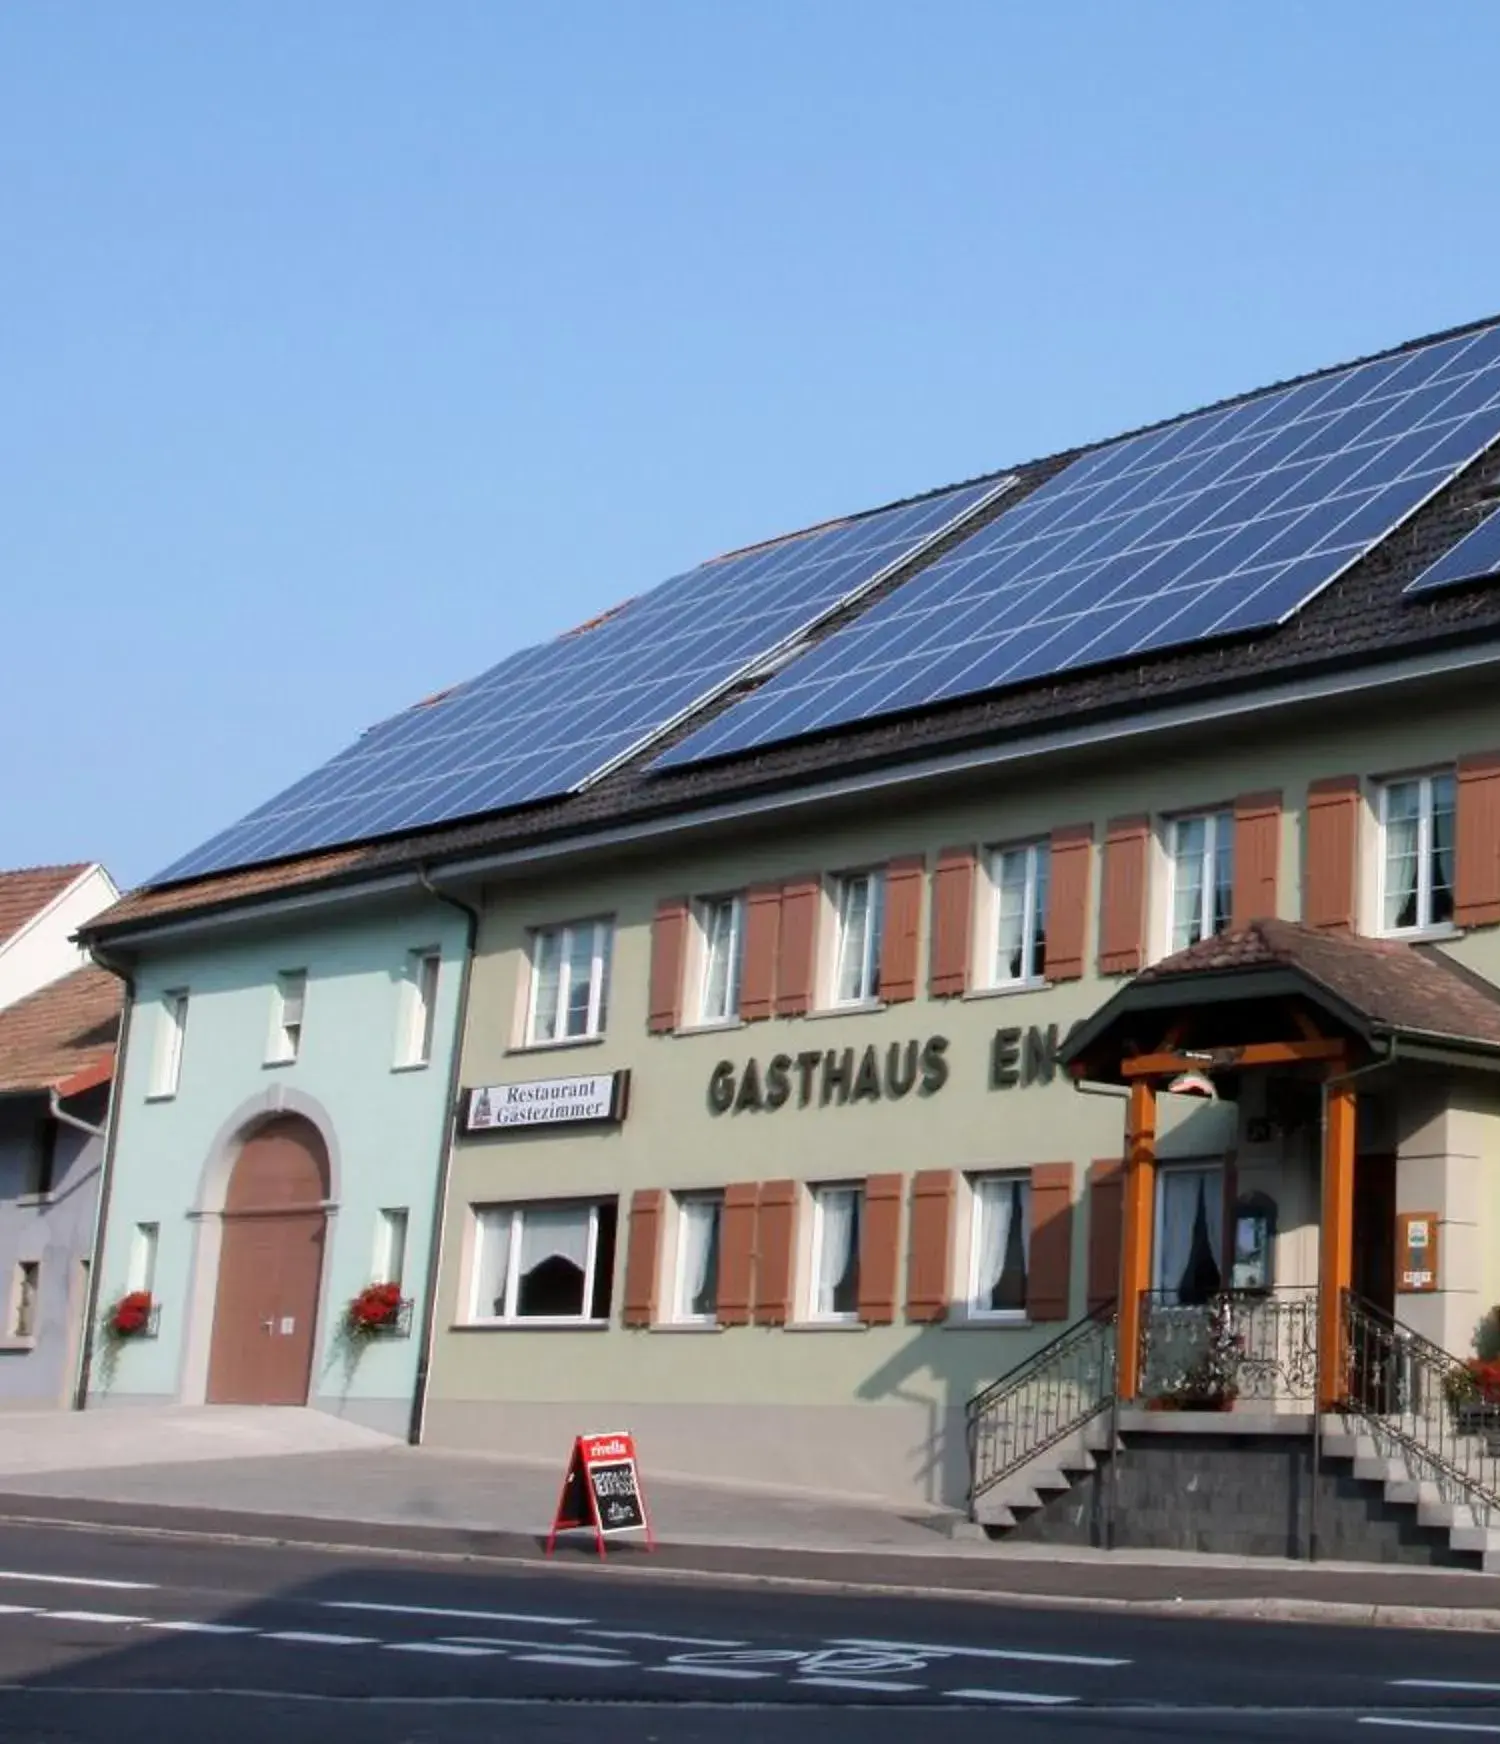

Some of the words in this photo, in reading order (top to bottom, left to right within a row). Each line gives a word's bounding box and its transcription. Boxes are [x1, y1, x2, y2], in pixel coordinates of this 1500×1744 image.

[708, 1034, 950, 1114] GASTHAUS
[506, 1079, 597, 1104] Restaurant
[496, 1101, 604, 1124] Gästezimmer
[591, 1440, 627, 1457] rivella
